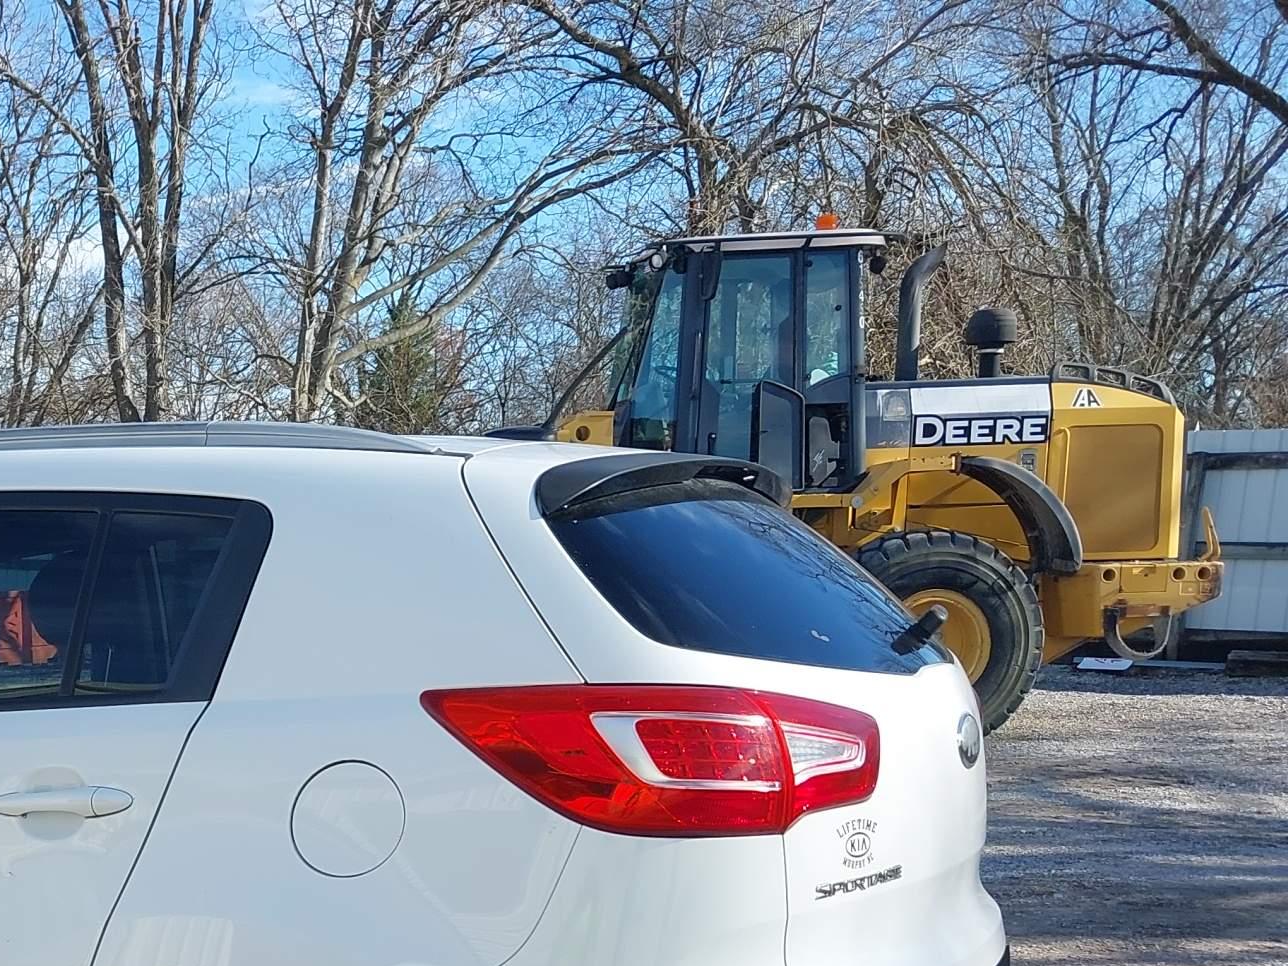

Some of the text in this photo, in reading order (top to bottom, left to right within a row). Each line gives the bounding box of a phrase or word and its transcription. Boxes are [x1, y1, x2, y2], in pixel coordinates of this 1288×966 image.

[914, 415, 1047, 446] DEERE
[836, 818, 878, 838] LIFETIME
[850, 837, 868, 852] KIA
